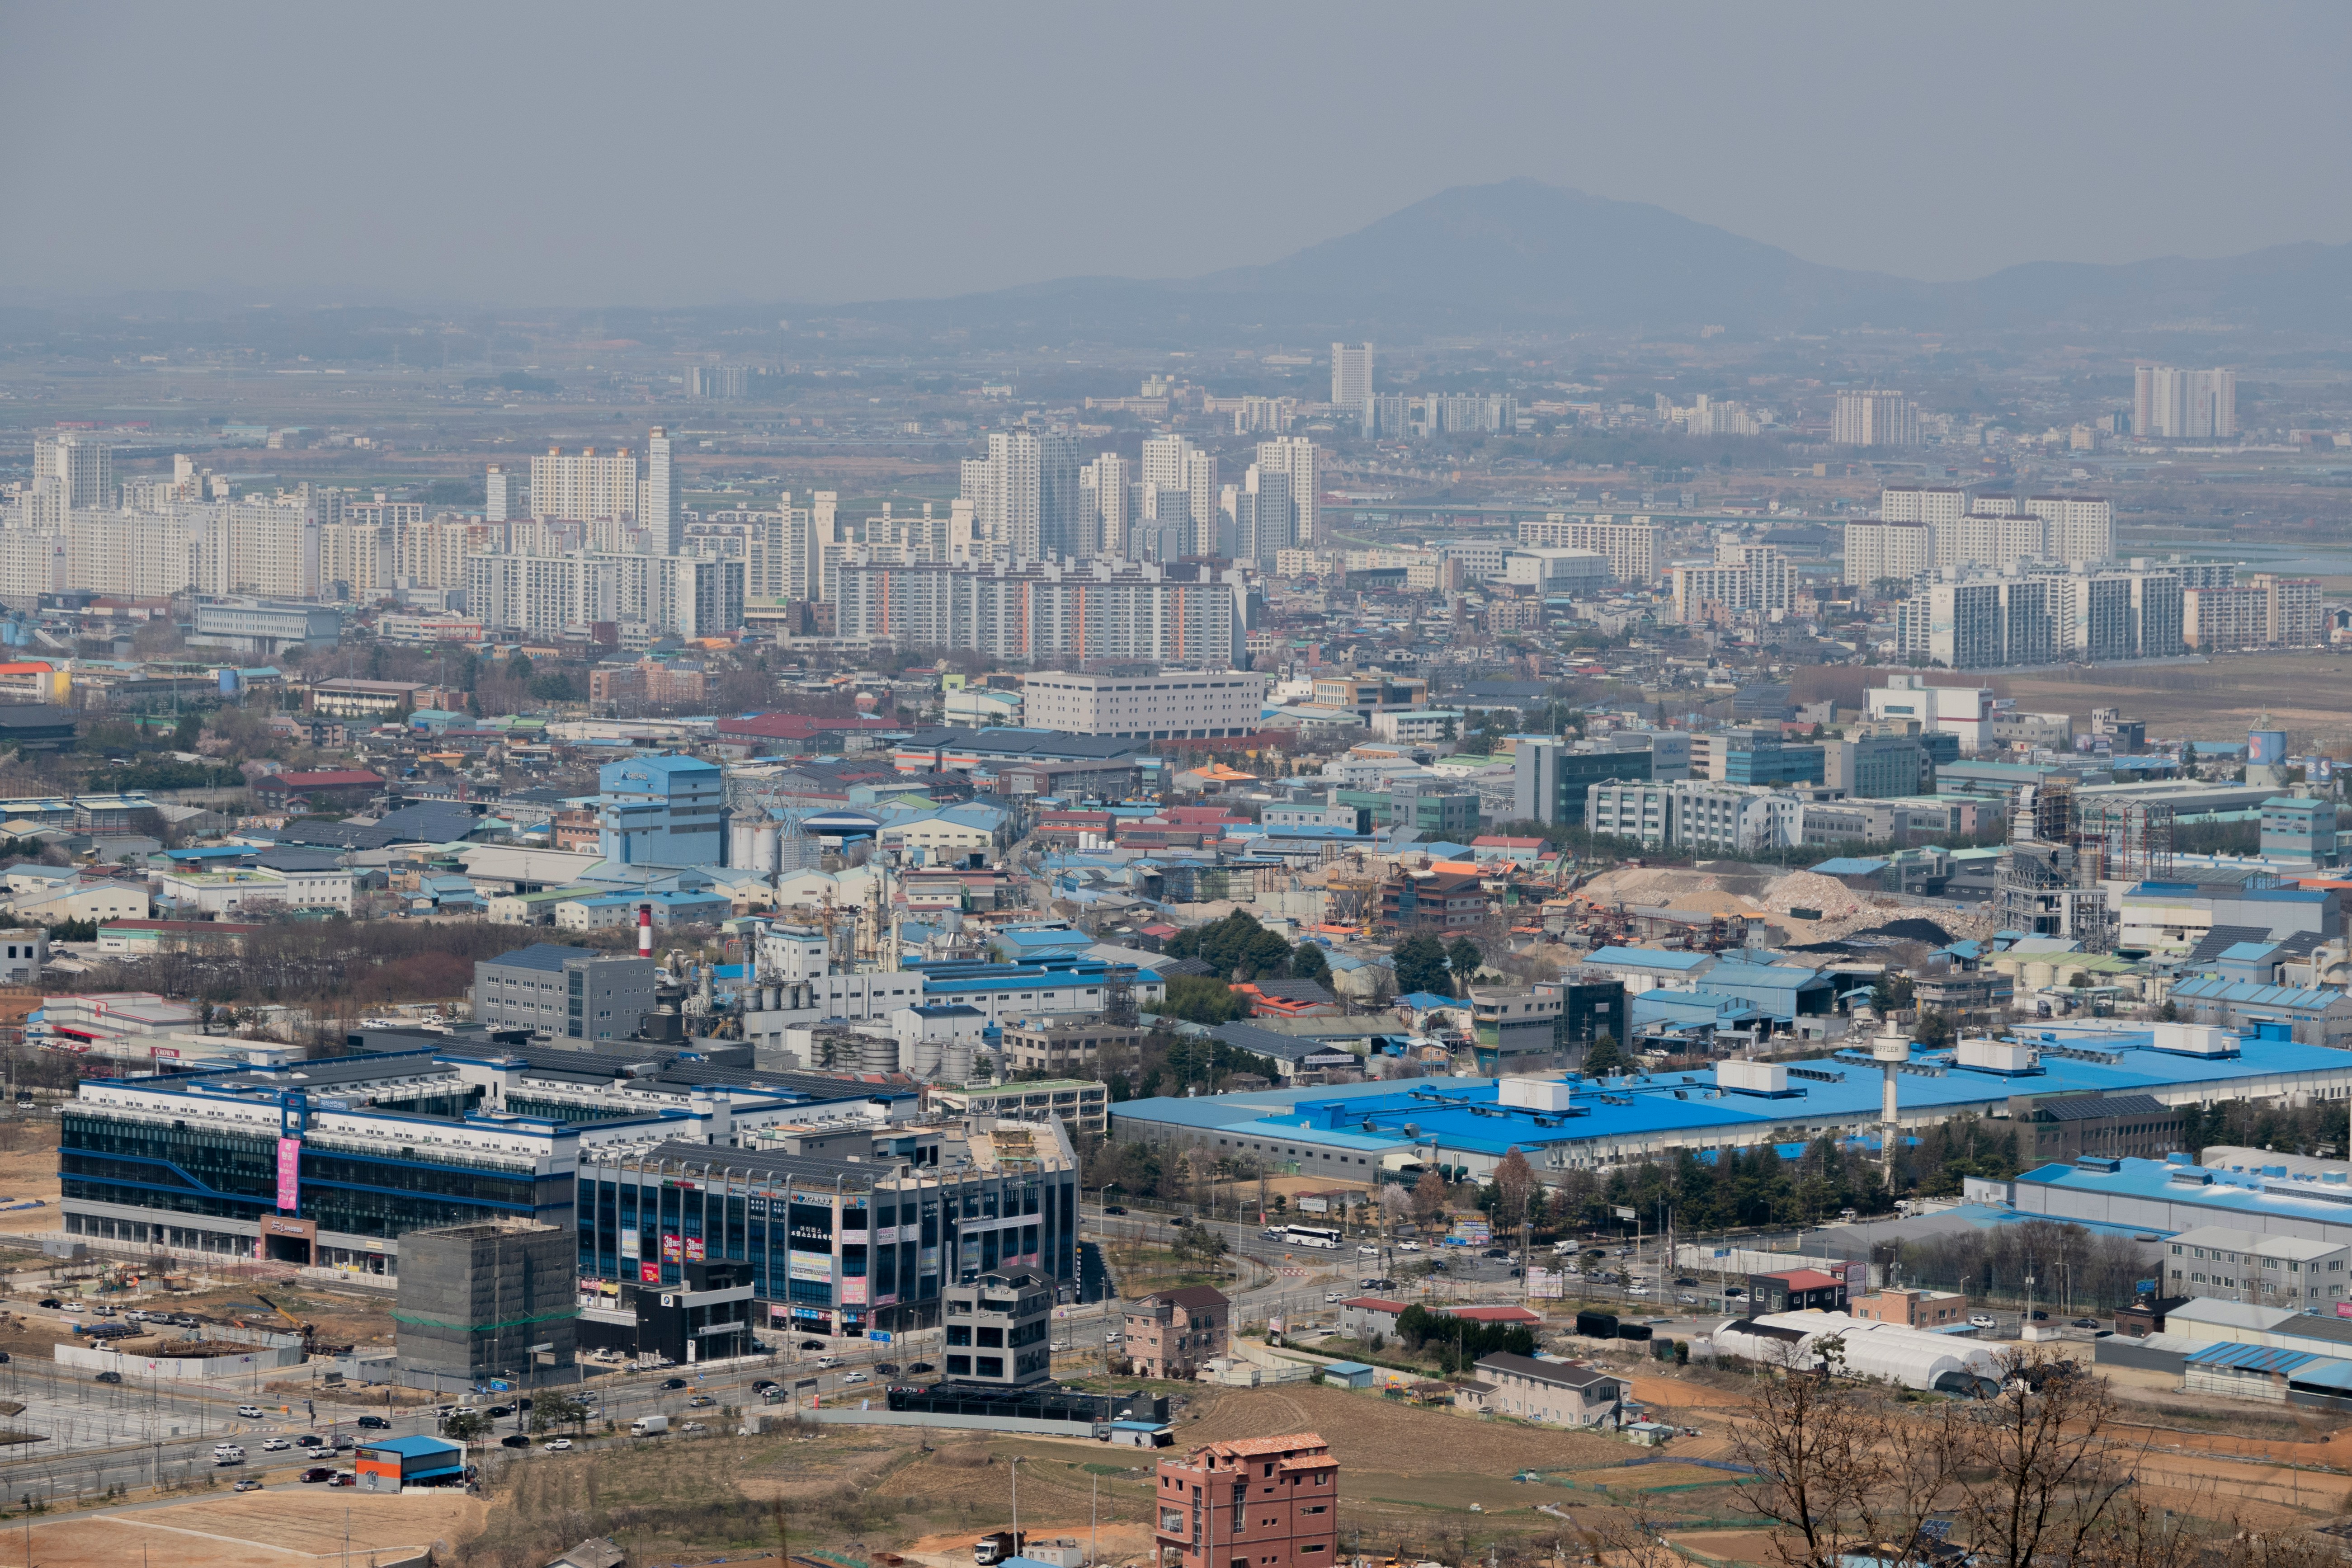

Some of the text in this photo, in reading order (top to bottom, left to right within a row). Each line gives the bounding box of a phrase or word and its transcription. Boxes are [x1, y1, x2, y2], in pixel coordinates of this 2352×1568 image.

[156, 1048, 175, 1057] CROWN
[320, 1100, 347, 1110] 지식산업센터
[800, 1225, 822, 1234] 아이리스
